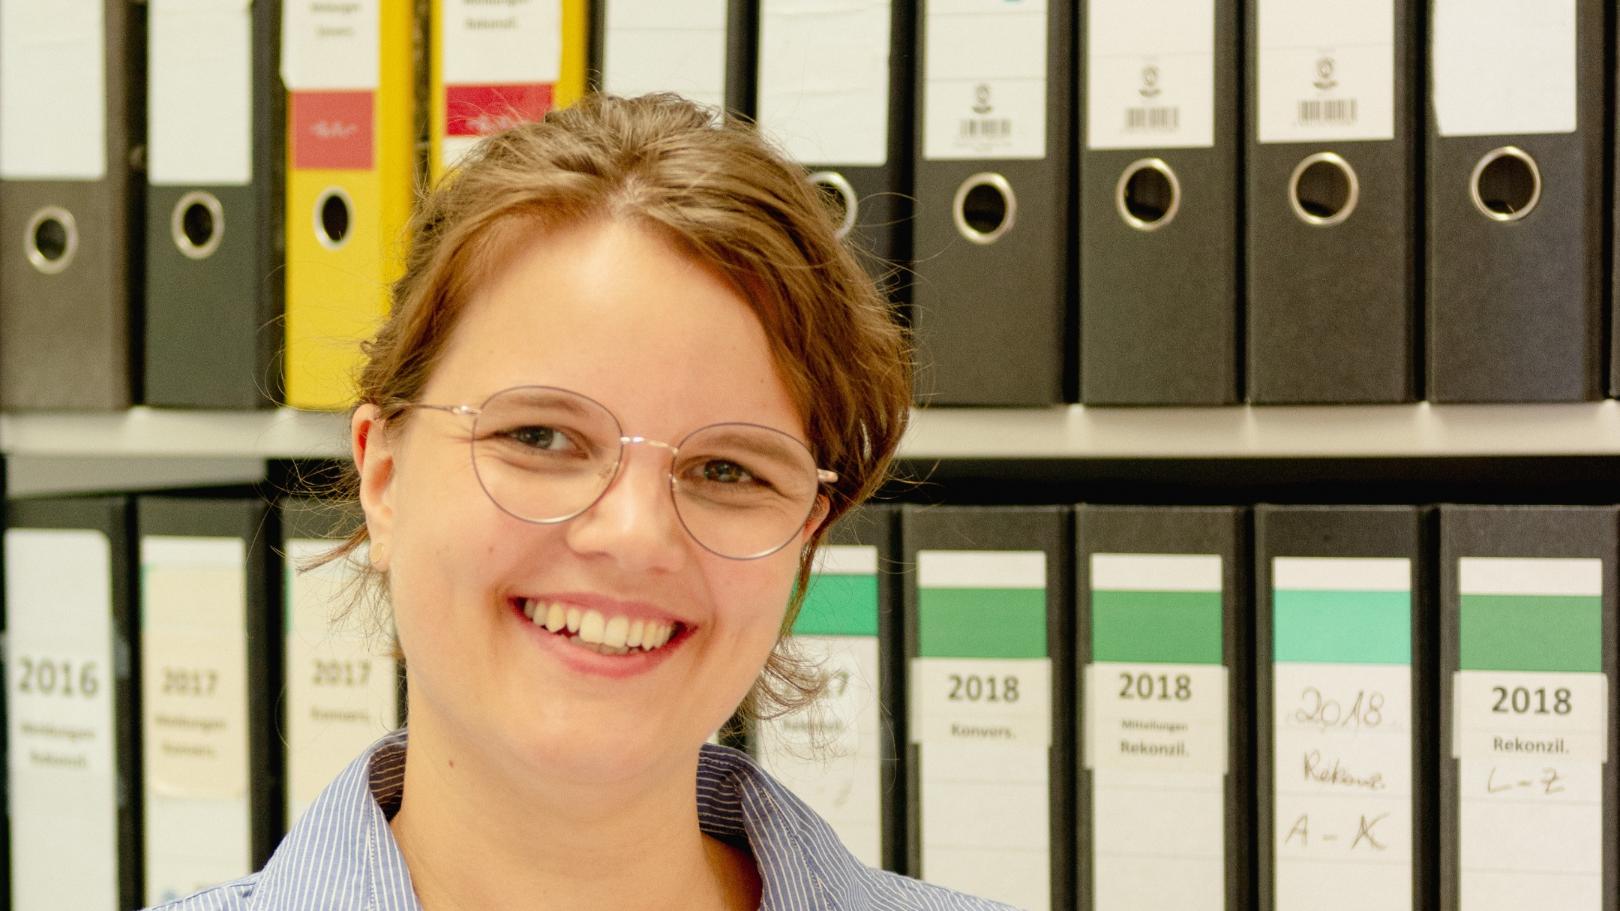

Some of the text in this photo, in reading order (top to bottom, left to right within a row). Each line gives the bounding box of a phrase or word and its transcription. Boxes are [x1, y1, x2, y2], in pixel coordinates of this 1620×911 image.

[18, 656, 98, 698] 2016
[162, 667, 219, 696] 2017
[313, 658, 371, 686] 2017
[1118, 672, 1191, 700] 2018
[948, 673, 1019, 702] 2018
[1492, 686, 1572, 714] 2018
[1296, 686, 1384, 727] 2018
[951, 722, 1016, 739] Konvers.
[1120, 740, 1189, 757] Rekonzil.
[1494, 737, 1569, 753] Rekonzil.
